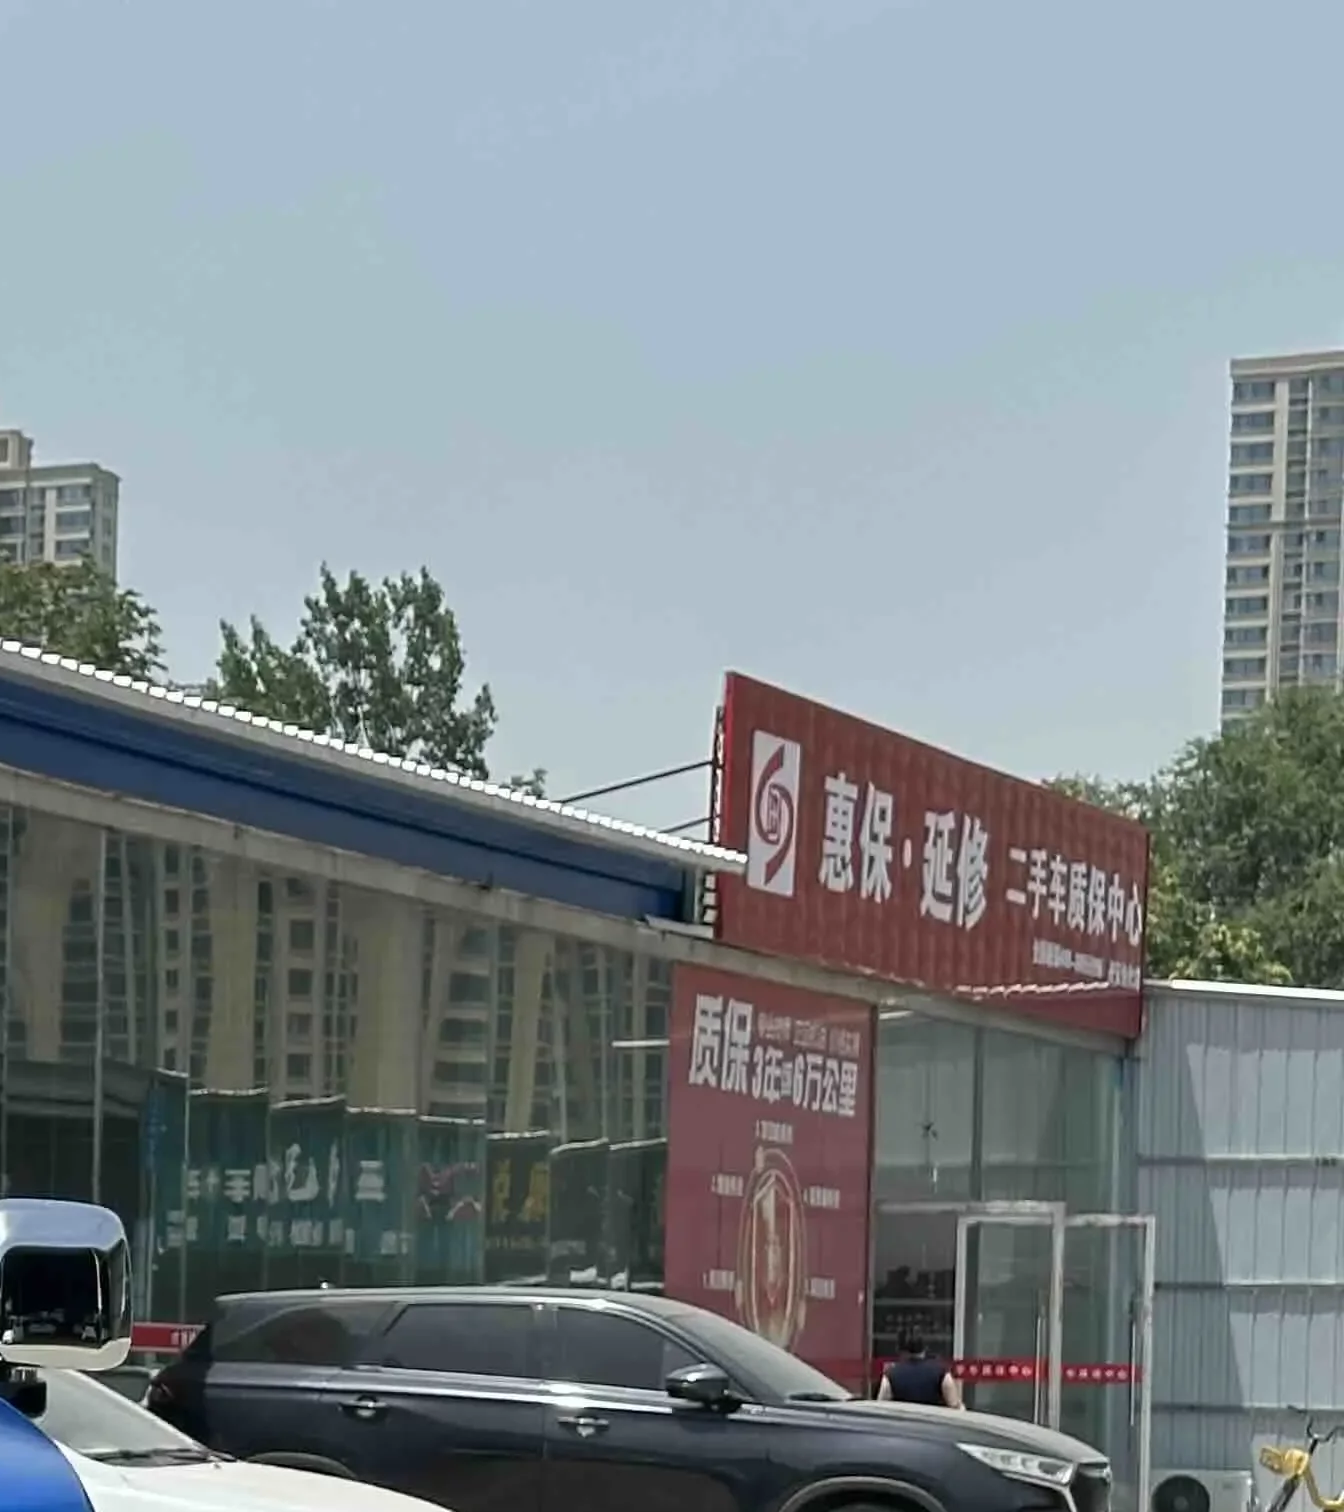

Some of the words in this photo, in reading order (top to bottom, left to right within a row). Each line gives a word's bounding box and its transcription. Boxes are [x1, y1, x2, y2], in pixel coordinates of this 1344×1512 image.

[1005, 847, 1142, 947] 二手车质保中心
[688, 993, 754, 1095] 质保
